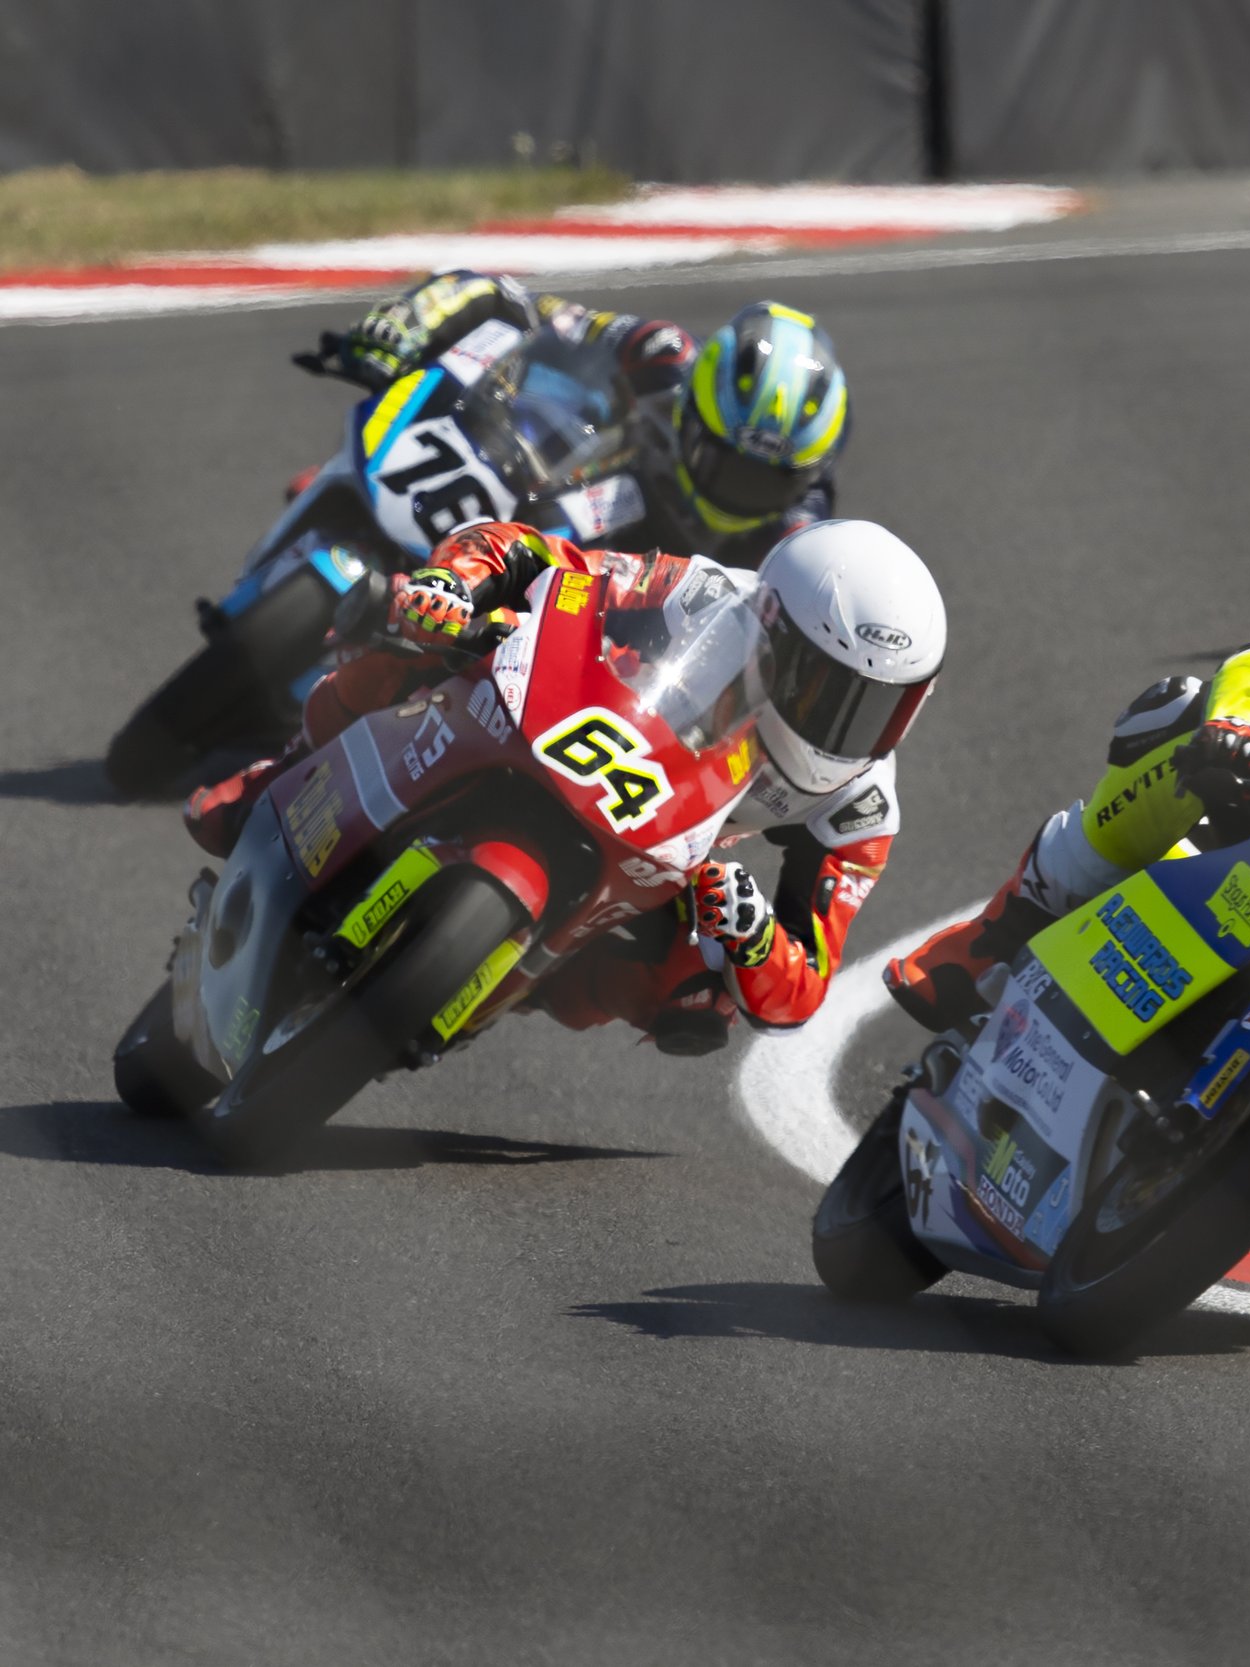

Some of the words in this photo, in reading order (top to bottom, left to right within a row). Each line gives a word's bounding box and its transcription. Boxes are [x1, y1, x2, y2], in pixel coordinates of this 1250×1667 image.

[863, 627, 907, 648] HJC
[541, 714, 662, 824] 64
[1089, 939, 1165, 1023] RACING
